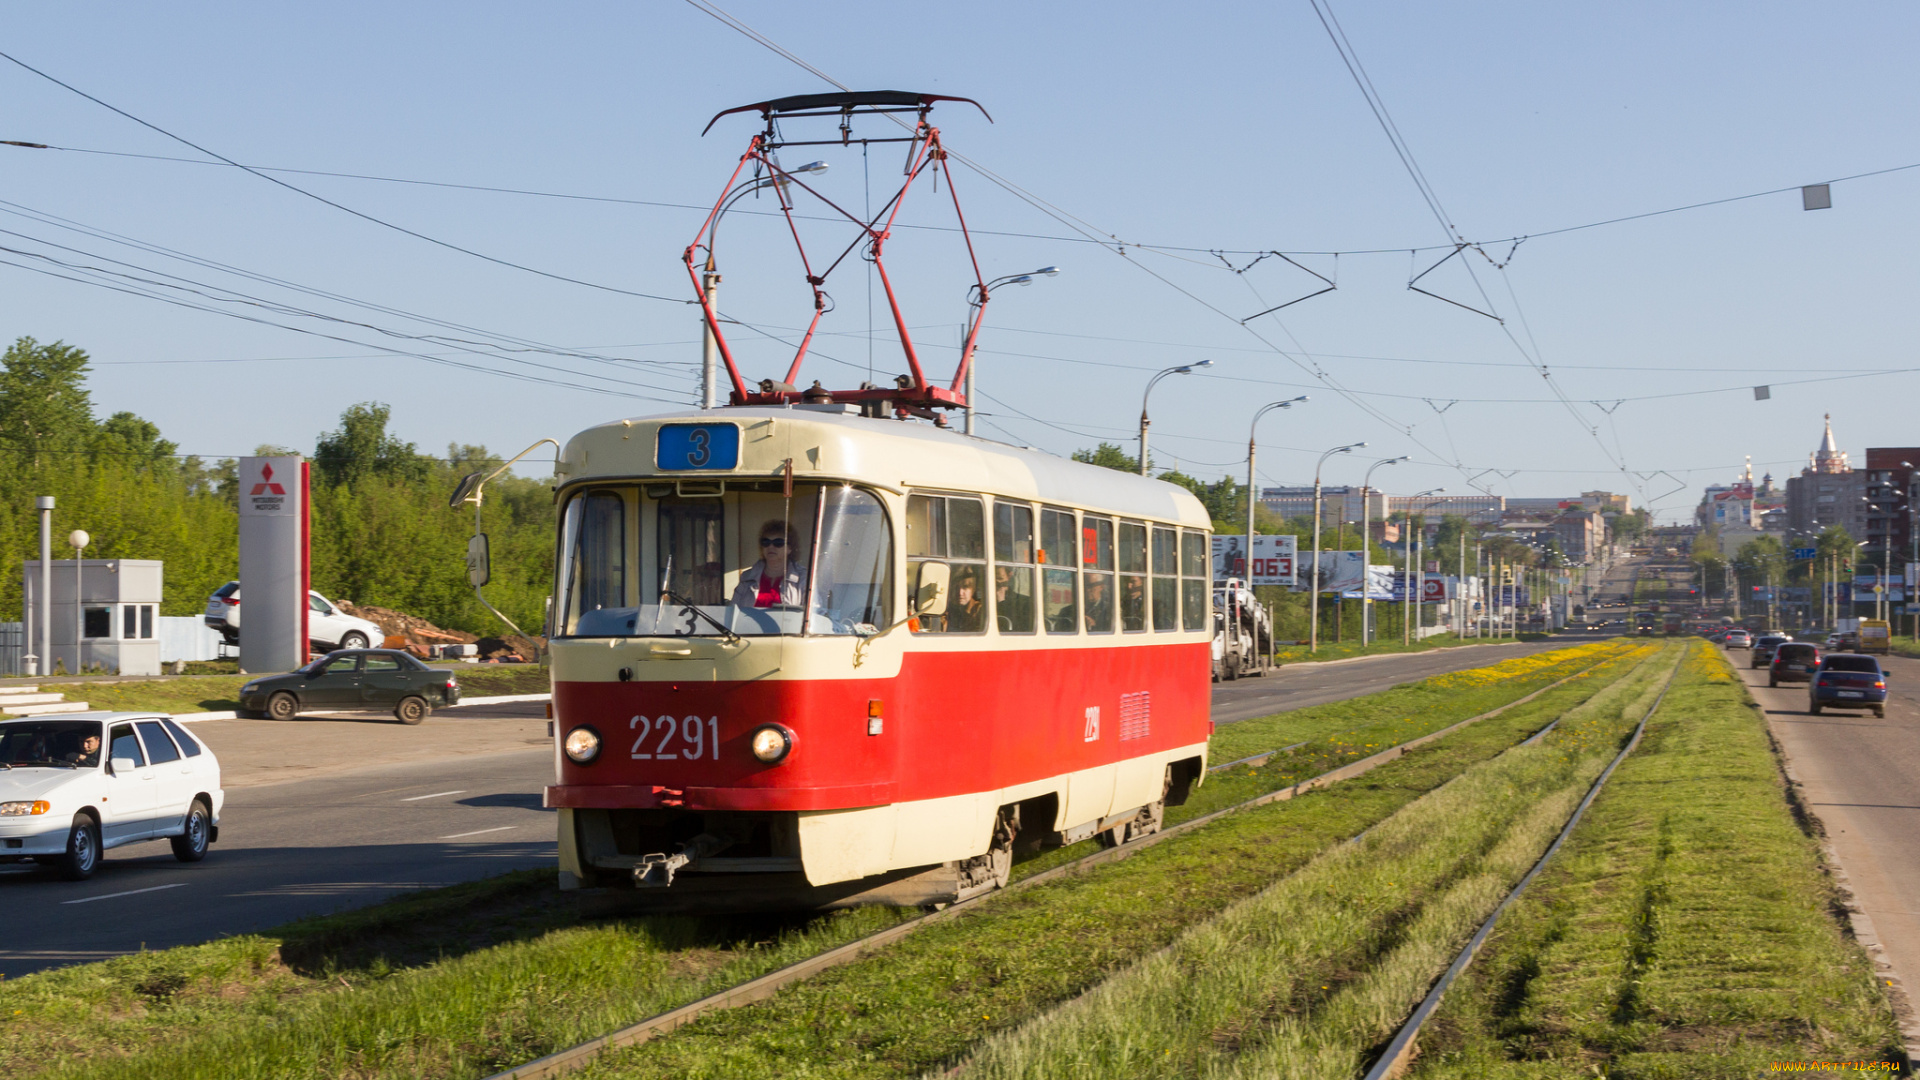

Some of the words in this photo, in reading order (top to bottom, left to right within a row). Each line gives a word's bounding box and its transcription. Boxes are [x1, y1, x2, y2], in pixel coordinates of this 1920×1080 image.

[688, 428, 711, 467] 3
[675, 607, 699, 636] 3
[629, 715, 719, 760] 2291
[1084, 706, 1100, 743] 2291
